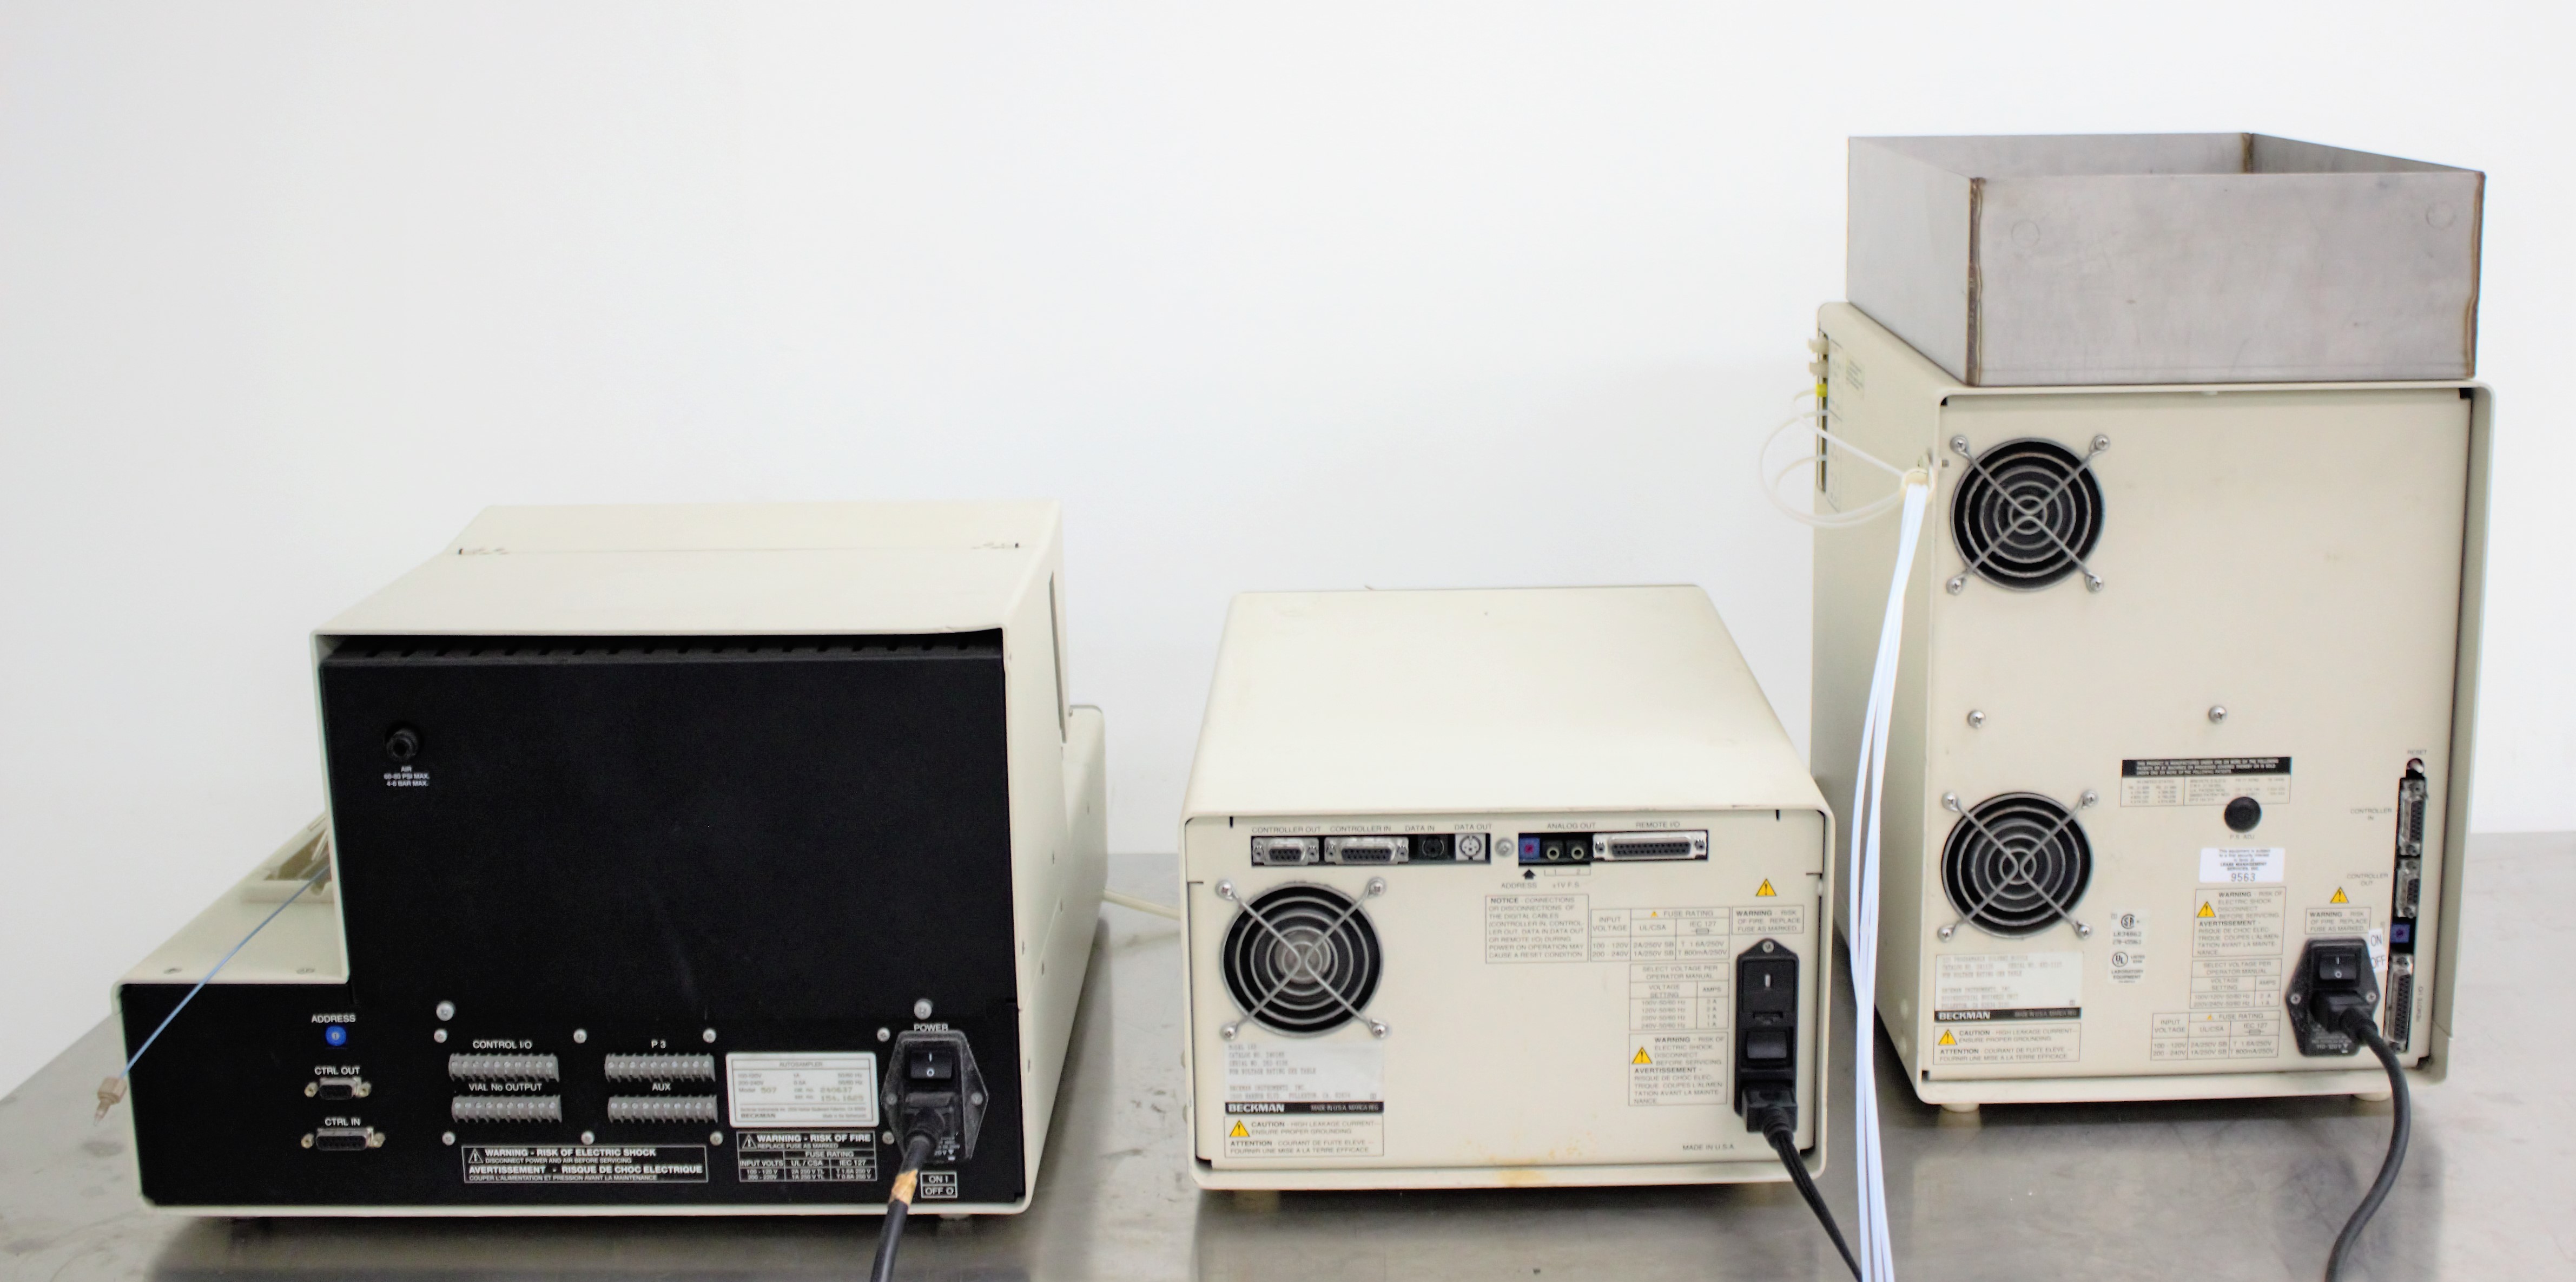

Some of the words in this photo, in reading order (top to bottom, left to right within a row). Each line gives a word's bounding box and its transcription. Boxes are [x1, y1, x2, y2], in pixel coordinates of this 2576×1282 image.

[1547, 822, 1577, 830] ANALOG
[2231, 873, 2256, 882] 9563
[2370, 935, 2382, 946] ON
[2371, 955, 2386, 969] OFF
[311, 1015, 356, 1023] ADDRESS
[1939, 1011, 1991, 1021] BECKMAN
[914, 1023, 948, 1031] POWER
[473, 1040, 516, 1049] CONTROL
[519, 1040, 532, 1049] I/O
[651, 1040, 657, 1049] P
[314, 1066, 338, 1075] CTRL
[340, 1066, 360, 1075] OUT
[469, 1083, 486, 1092] VIAL
[505, 1083, 542, 1092] OUTPUT
[1228, 1104, 1285, 1112] BECKMAN
[325, 1118, 348, 1127] CTRL
[351, 1118, 361, 1127] IN
[485, 1149, 528, 1157] WARNING
[536, 1149, 558, 1157] RISK
[560, 1149, 572, 1157] OF
[575, 1149, 620, 1157] ELECTRIC
[623, 1149, 656, 1157] SHOCK
[469, 1166, 545, 1174] AVERTISSEMENT
[561, 1166, 596, 1174] RISQUE
[598, 1166, 612, 1174] DE
[614, 1166, 641, 1174] CHOC
[643, 1166, 702, 1174] ELECTRIQUE
[929, 1175, 942, 1184] ON
[925, 1187, 943, 1195] OFF
